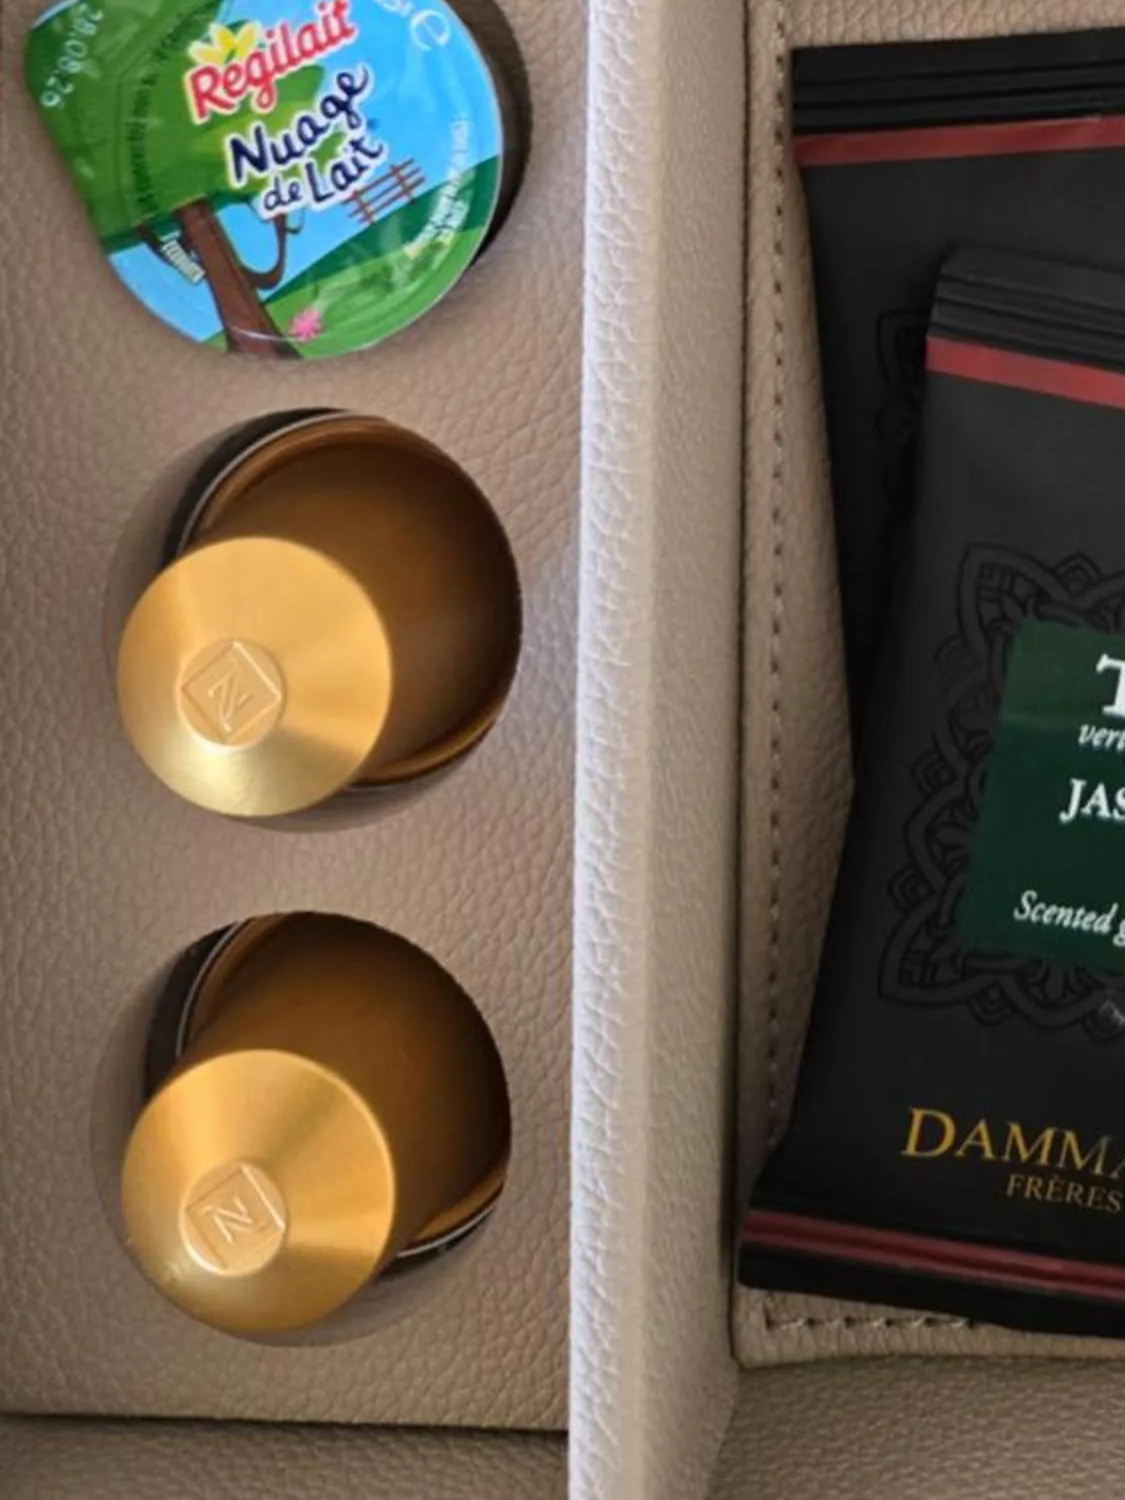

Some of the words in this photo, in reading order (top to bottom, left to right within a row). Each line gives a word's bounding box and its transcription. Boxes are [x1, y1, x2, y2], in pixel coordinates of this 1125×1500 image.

[230, 67, 368, 180] Nuage
[262, 181, 301, 213] de
[309, 136, 382, 202] Lait
[1013, 889, 1119, 935] Scented
[1005, 1171, 1125, 1214] FRÈRES
